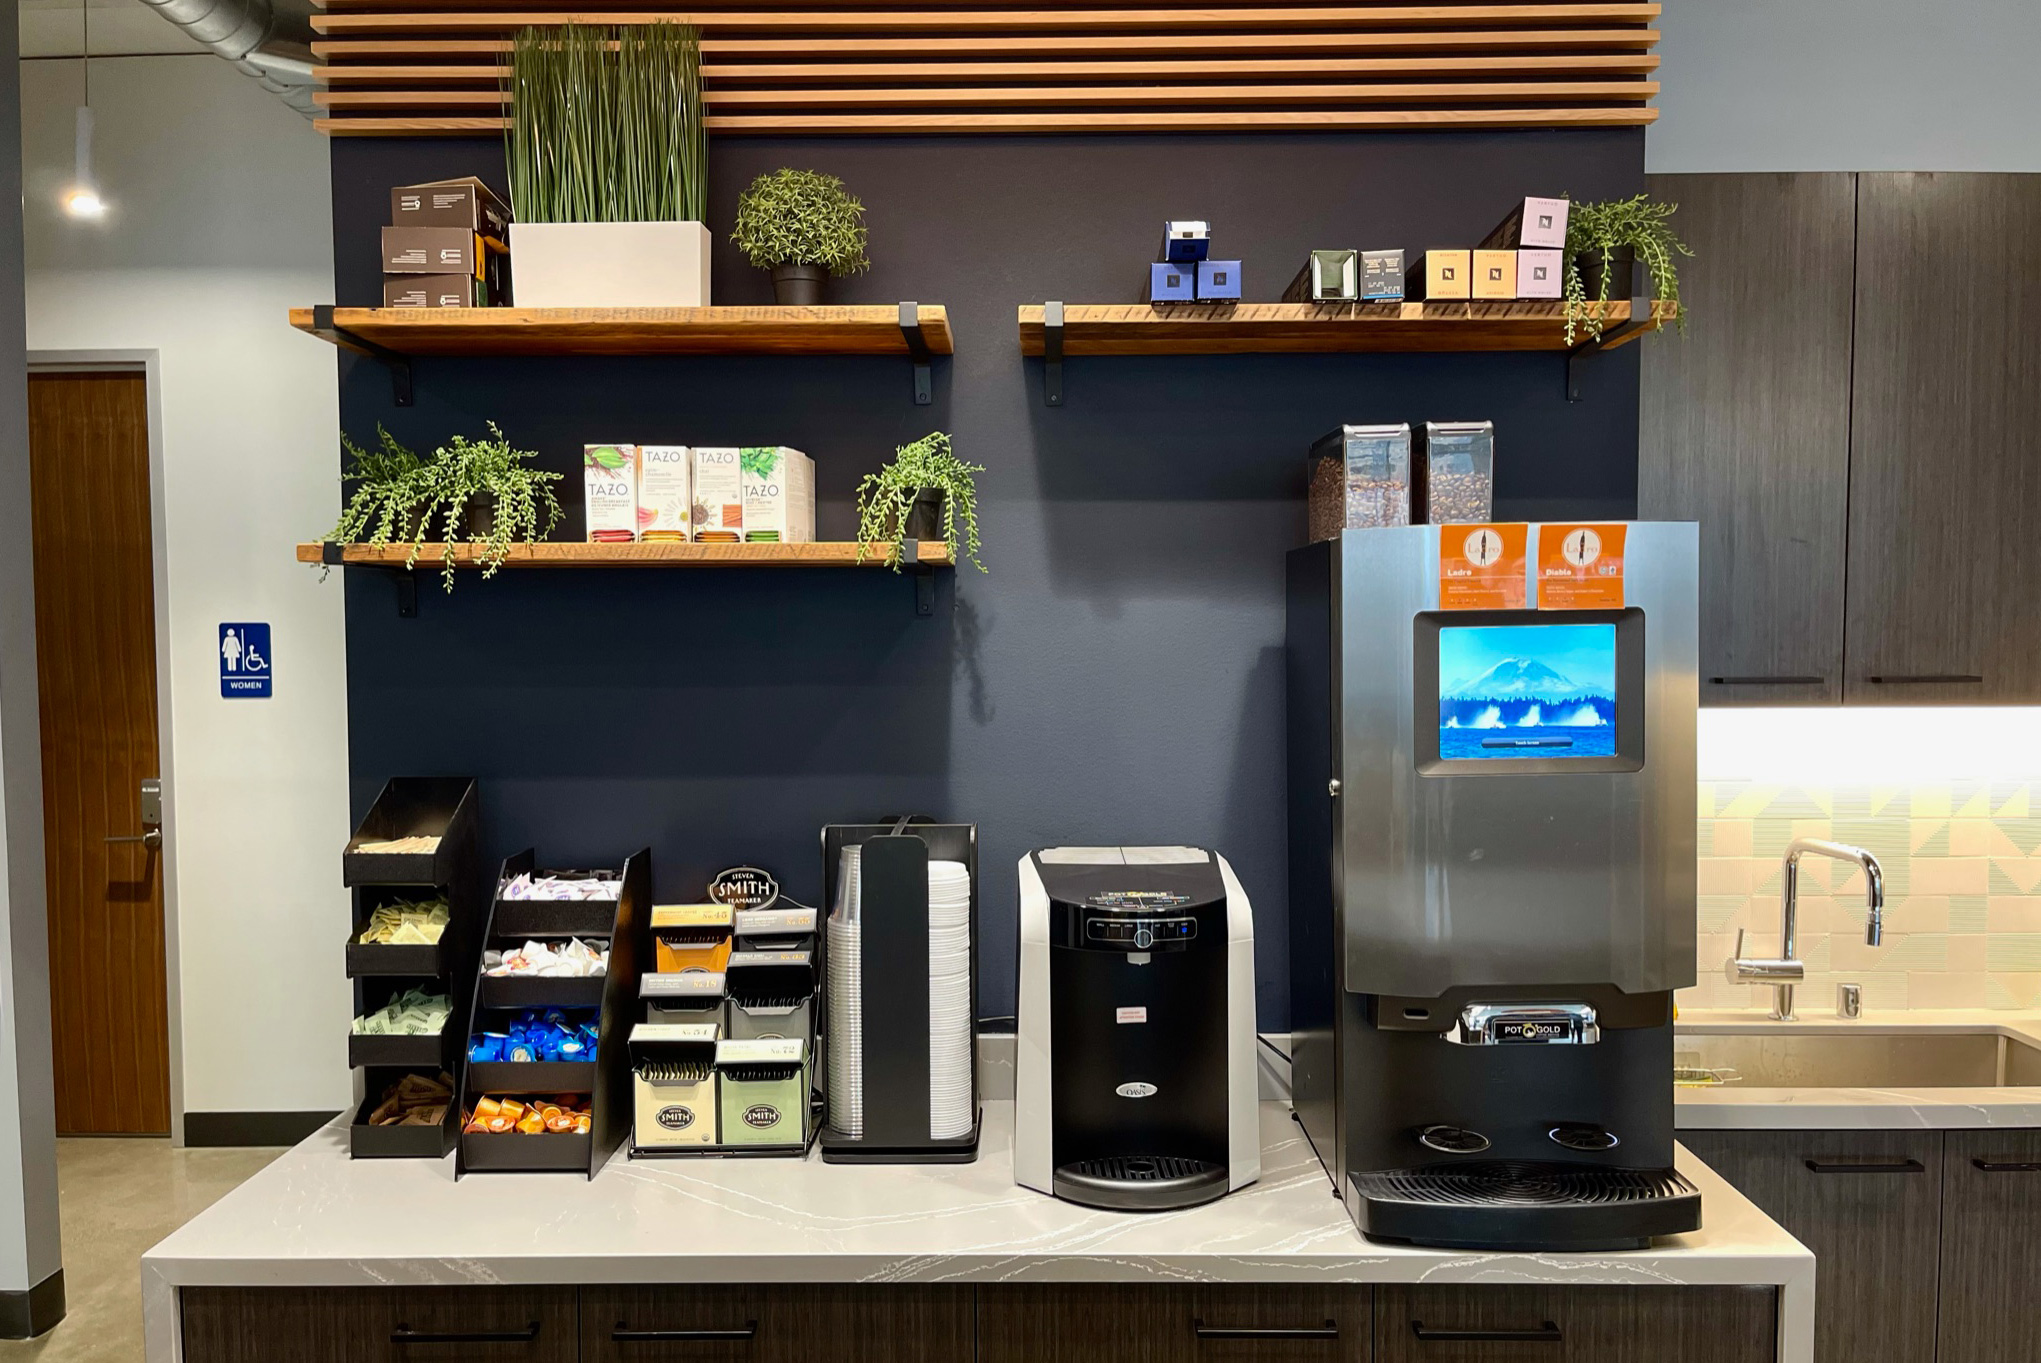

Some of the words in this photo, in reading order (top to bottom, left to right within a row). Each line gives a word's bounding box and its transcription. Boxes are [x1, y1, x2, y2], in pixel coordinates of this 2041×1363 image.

[645, 451, 680, 463] TAZO
[699, 452, 734, 464] TAZO
[588, 483, 628, 496] TAZO
[743, 485, 779, 497] TAZO
[1447, 568, 1472, 576] Ladro
[1546, 568, 1572, 576] Diablo
[230, 681, 262, 689] WOMEN
[718, 880, 770, 897] SMITH
[1504, 1026, 1522, 1034] POT
[661, 1113, 690, 1122] SMITH
[747, 1112, 776, 1121] SMITH
